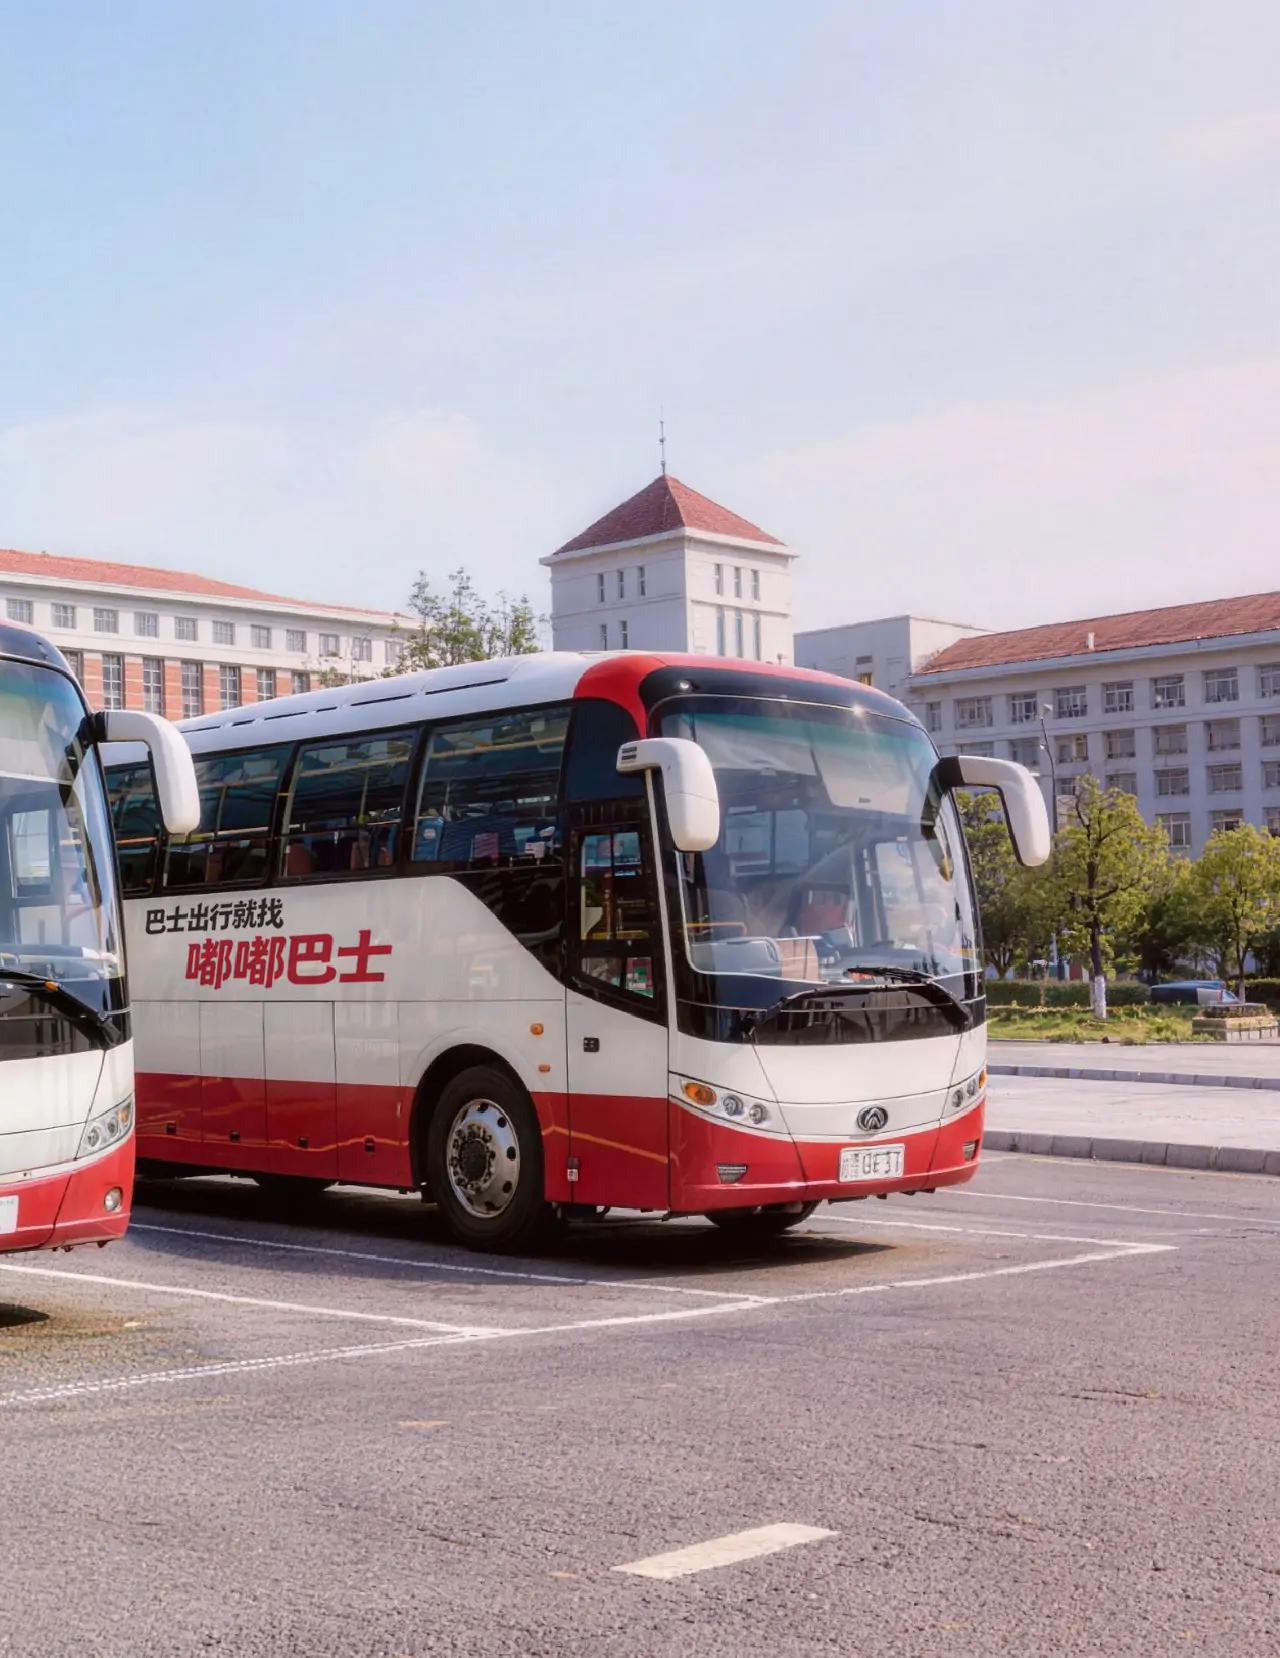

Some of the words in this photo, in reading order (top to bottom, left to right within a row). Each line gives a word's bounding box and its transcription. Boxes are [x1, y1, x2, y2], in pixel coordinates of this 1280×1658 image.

[145, 897, 284, 935] 巴士出行就找
[185, 929, 393, 990] 嘟嘟巴士
